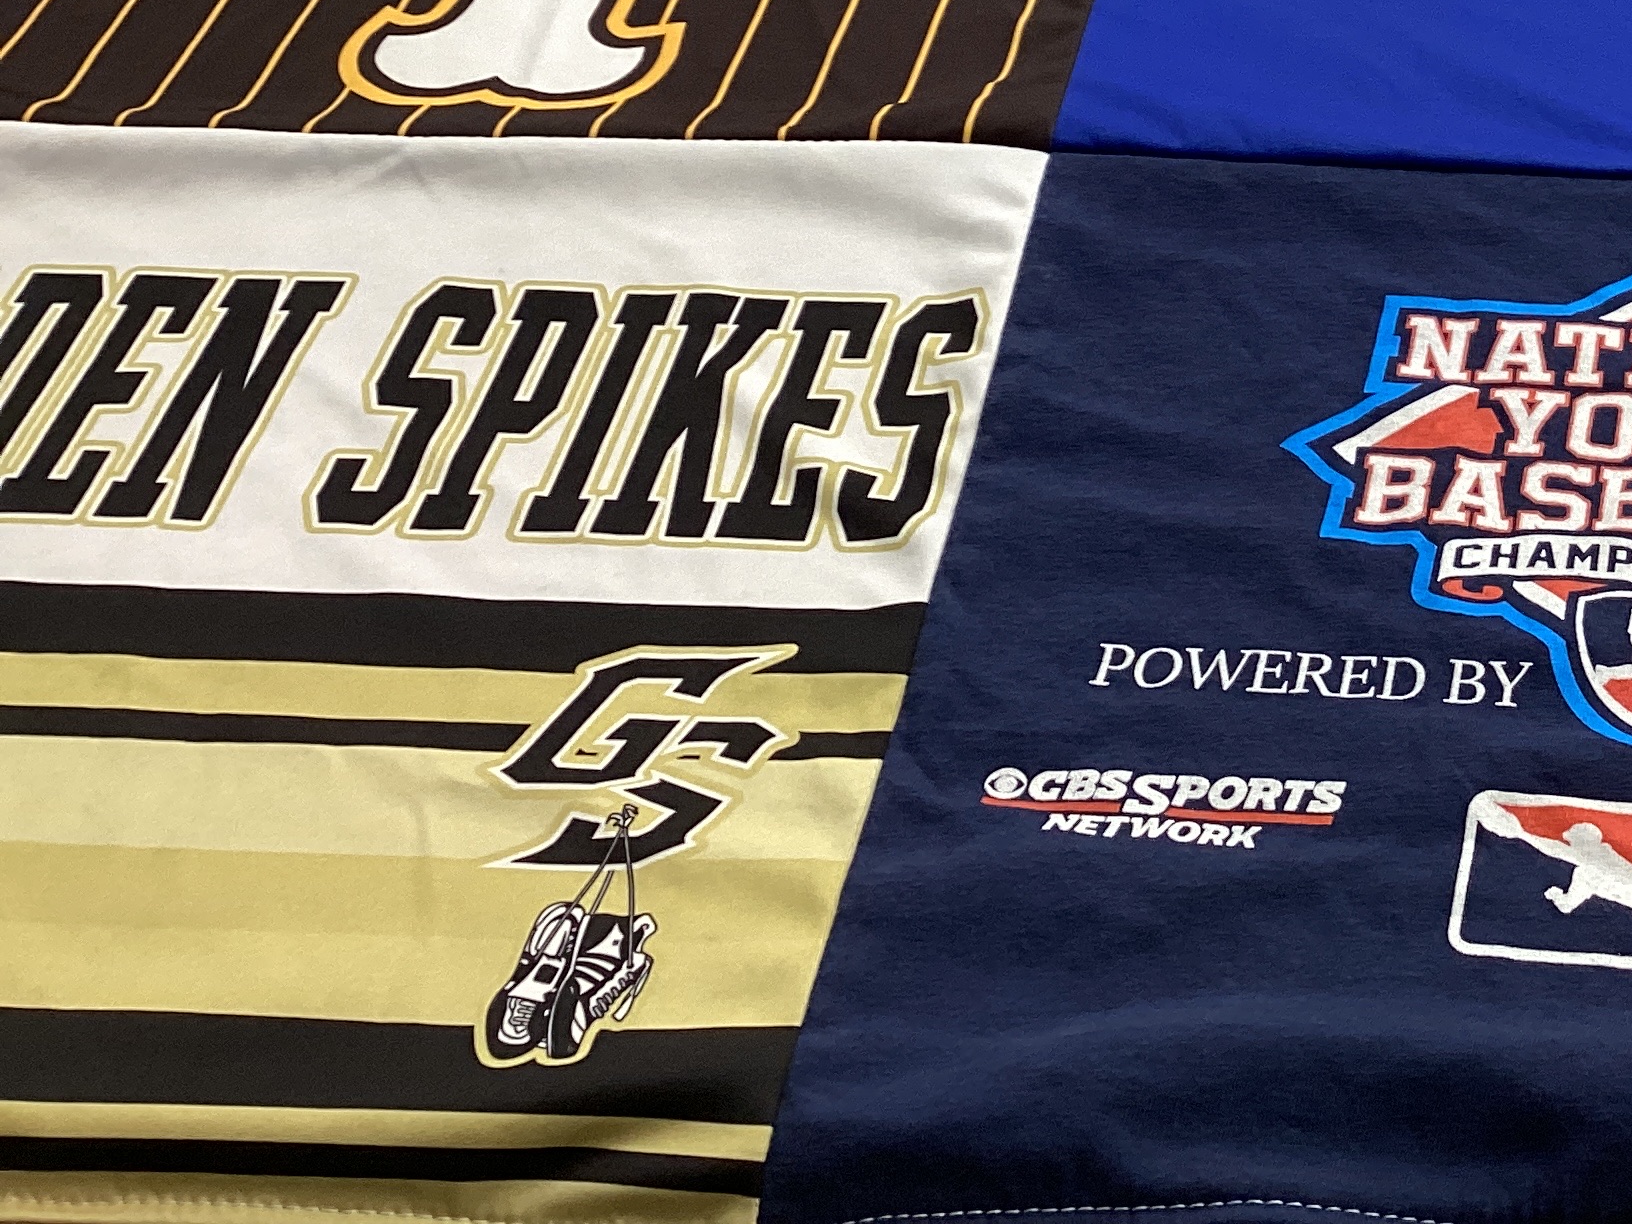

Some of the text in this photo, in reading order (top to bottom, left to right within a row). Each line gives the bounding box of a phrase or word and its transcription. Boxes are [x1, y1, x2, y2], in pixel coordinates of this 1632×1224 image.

[302, 278, 992, 552] SPIKES
[1088, 642, 1534, 708] POWERED BY
[1040, 813, 1263, 849] NETWORK
